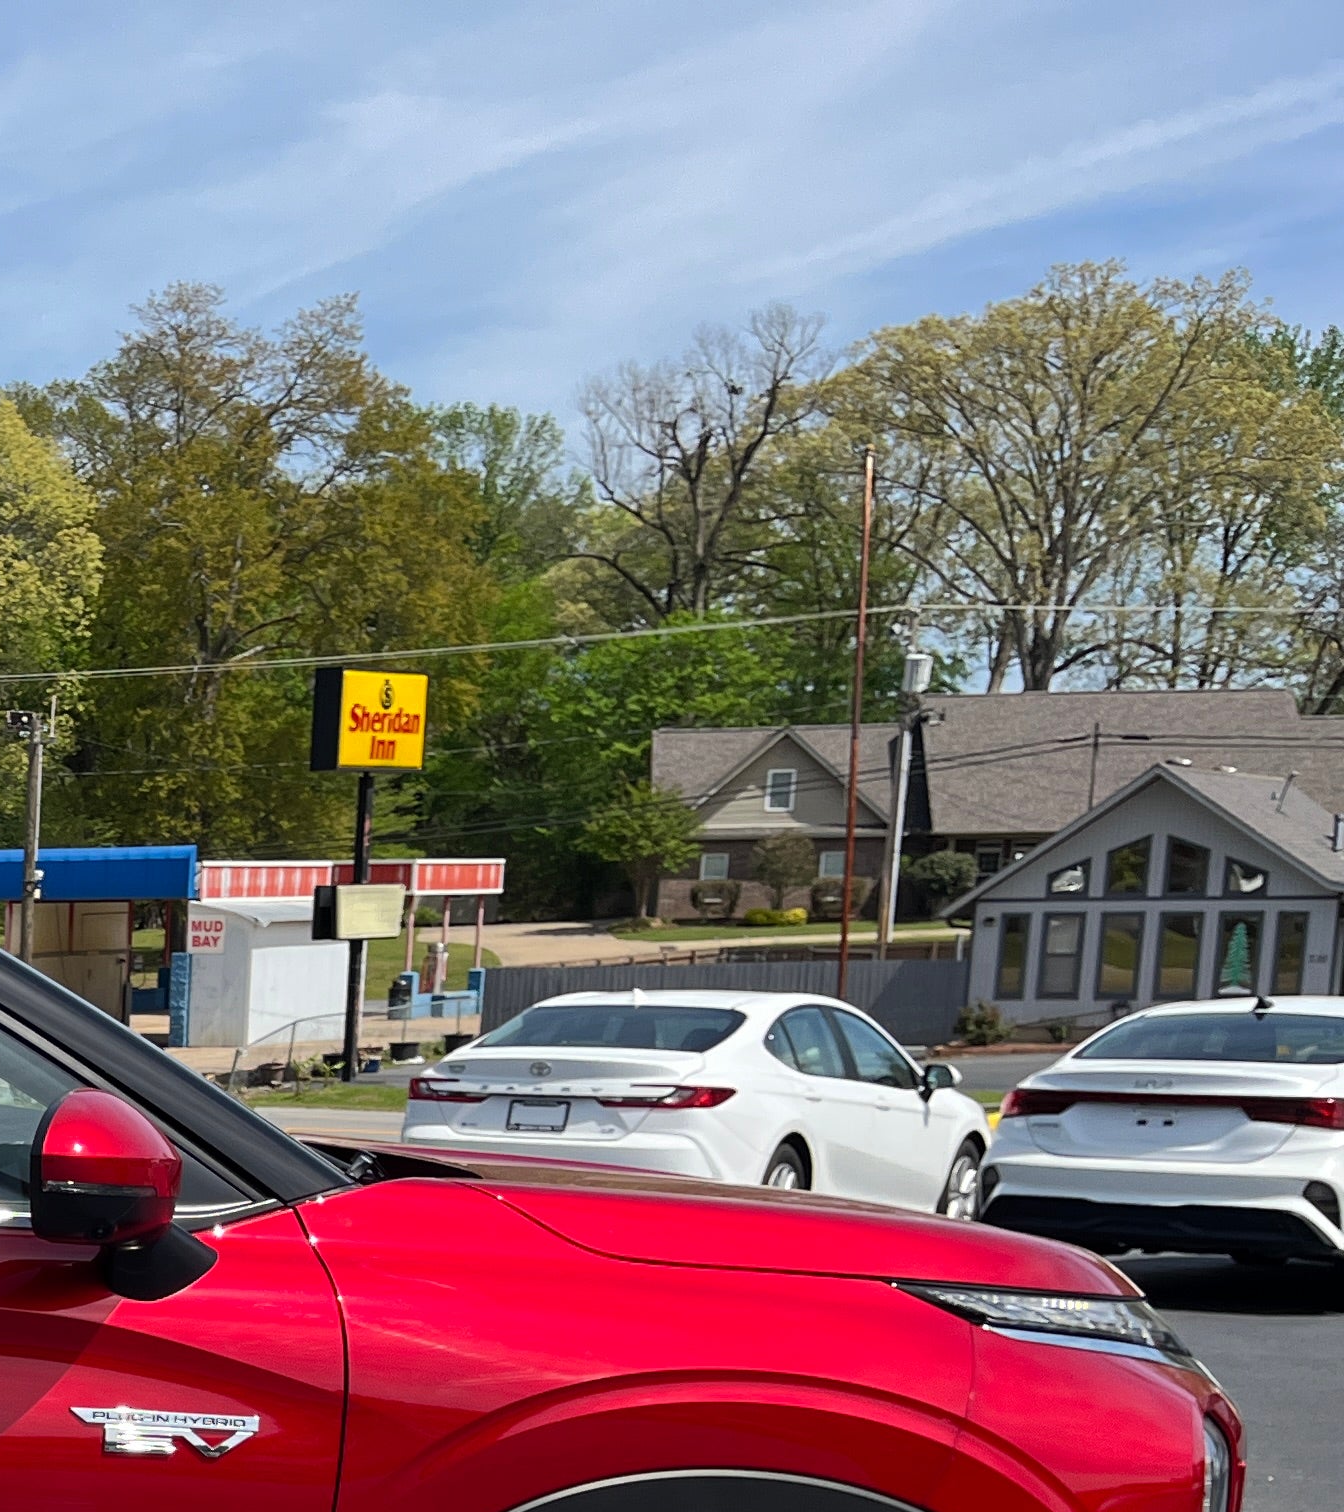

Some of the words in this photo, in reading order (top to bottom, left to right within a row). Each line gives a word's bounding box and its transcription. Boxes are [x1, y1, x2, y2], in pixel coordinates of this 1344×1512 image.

[349, 703, 420, 734] Sheridan
[370, 735, 396, 760] Inn
[191, 920, 224, 932] MUD
[192, 935, 221, 947] BAY
[92, 1411, 170, 1423] PLUG-IN
[174, 1415, 246, 1428] HYBRID
